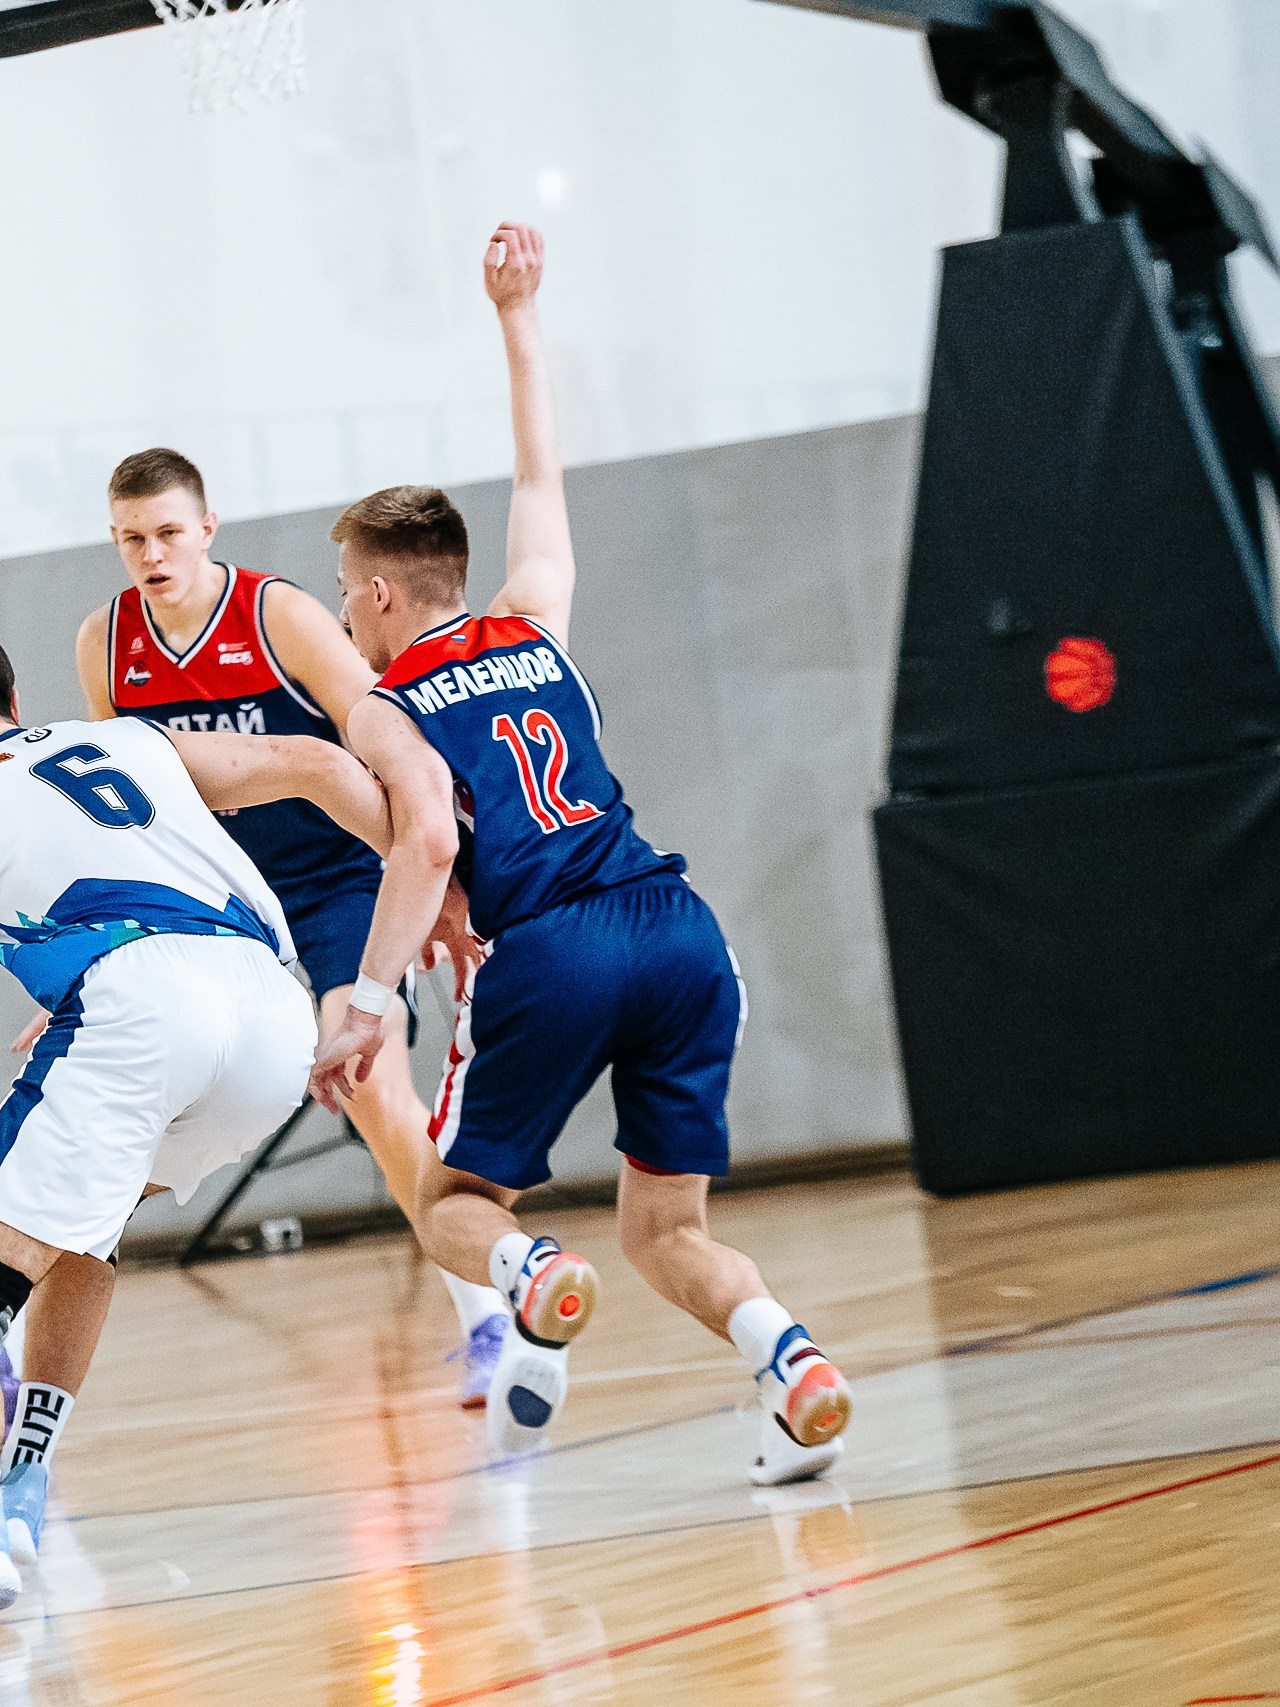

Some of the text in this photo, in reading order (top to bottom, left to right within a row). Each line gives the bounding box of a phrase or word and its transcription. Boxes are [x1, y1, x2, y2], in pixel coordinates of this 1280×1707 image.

[168, 702, 266, 734] ЛТАЙ
[404, 646, 563, 715] МЕЛЕНЦОВ
[28, 742, 156, 829] 6
[492, 708, 606, 834] 12
